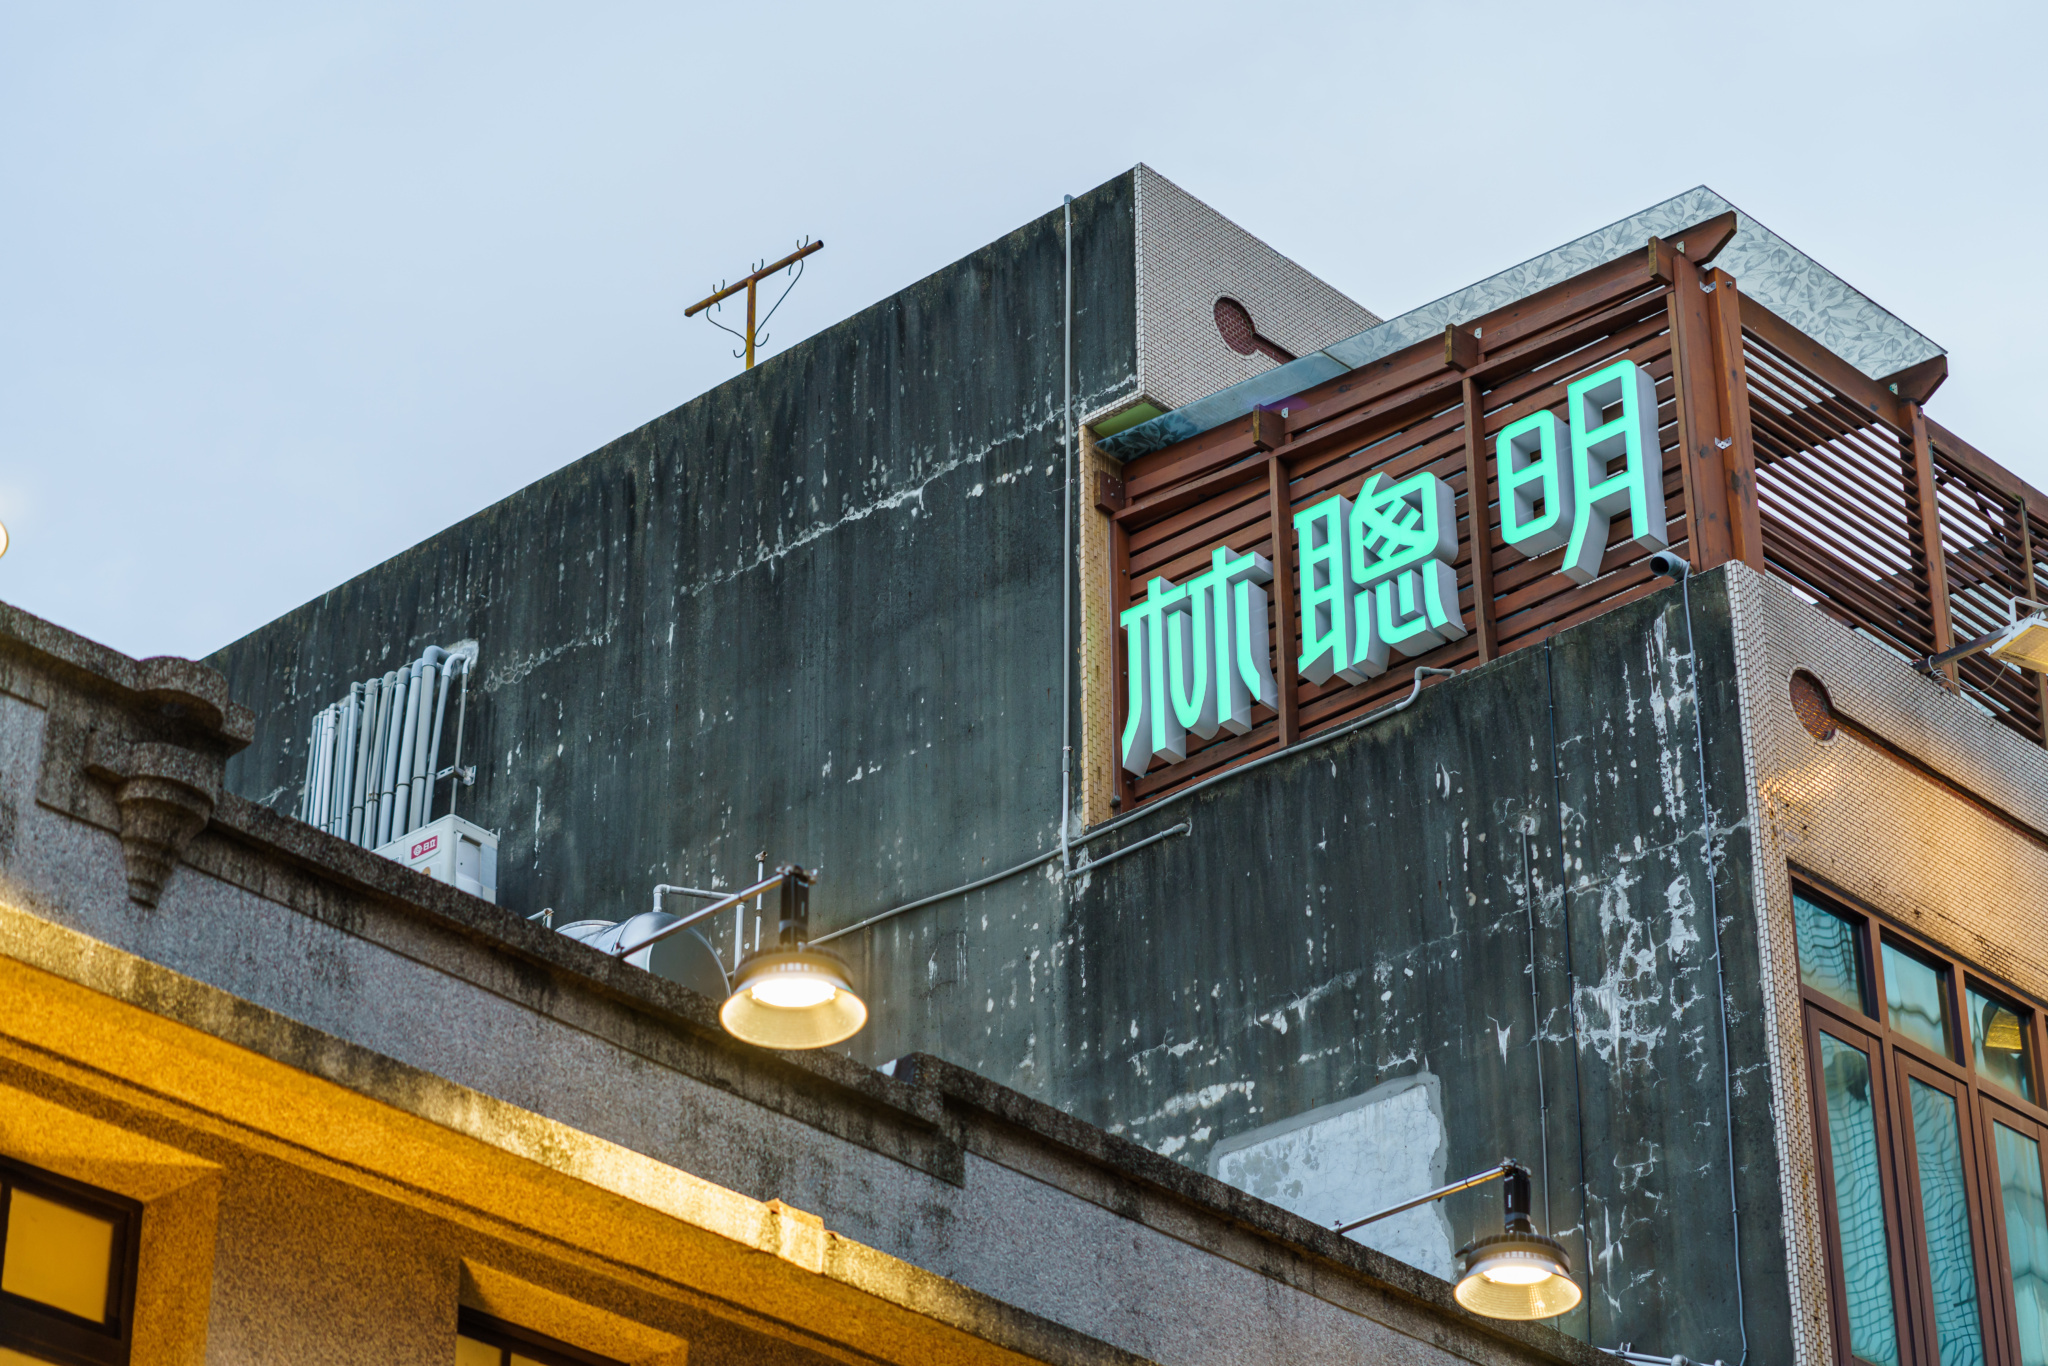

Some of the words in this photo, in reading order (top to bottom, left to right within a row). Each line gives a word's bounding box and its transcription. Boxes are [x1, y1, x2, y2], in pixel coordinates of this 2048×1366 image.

[1120, 359, 1650, 765] 林聰明
[423, 839, 436, 852] 日立
